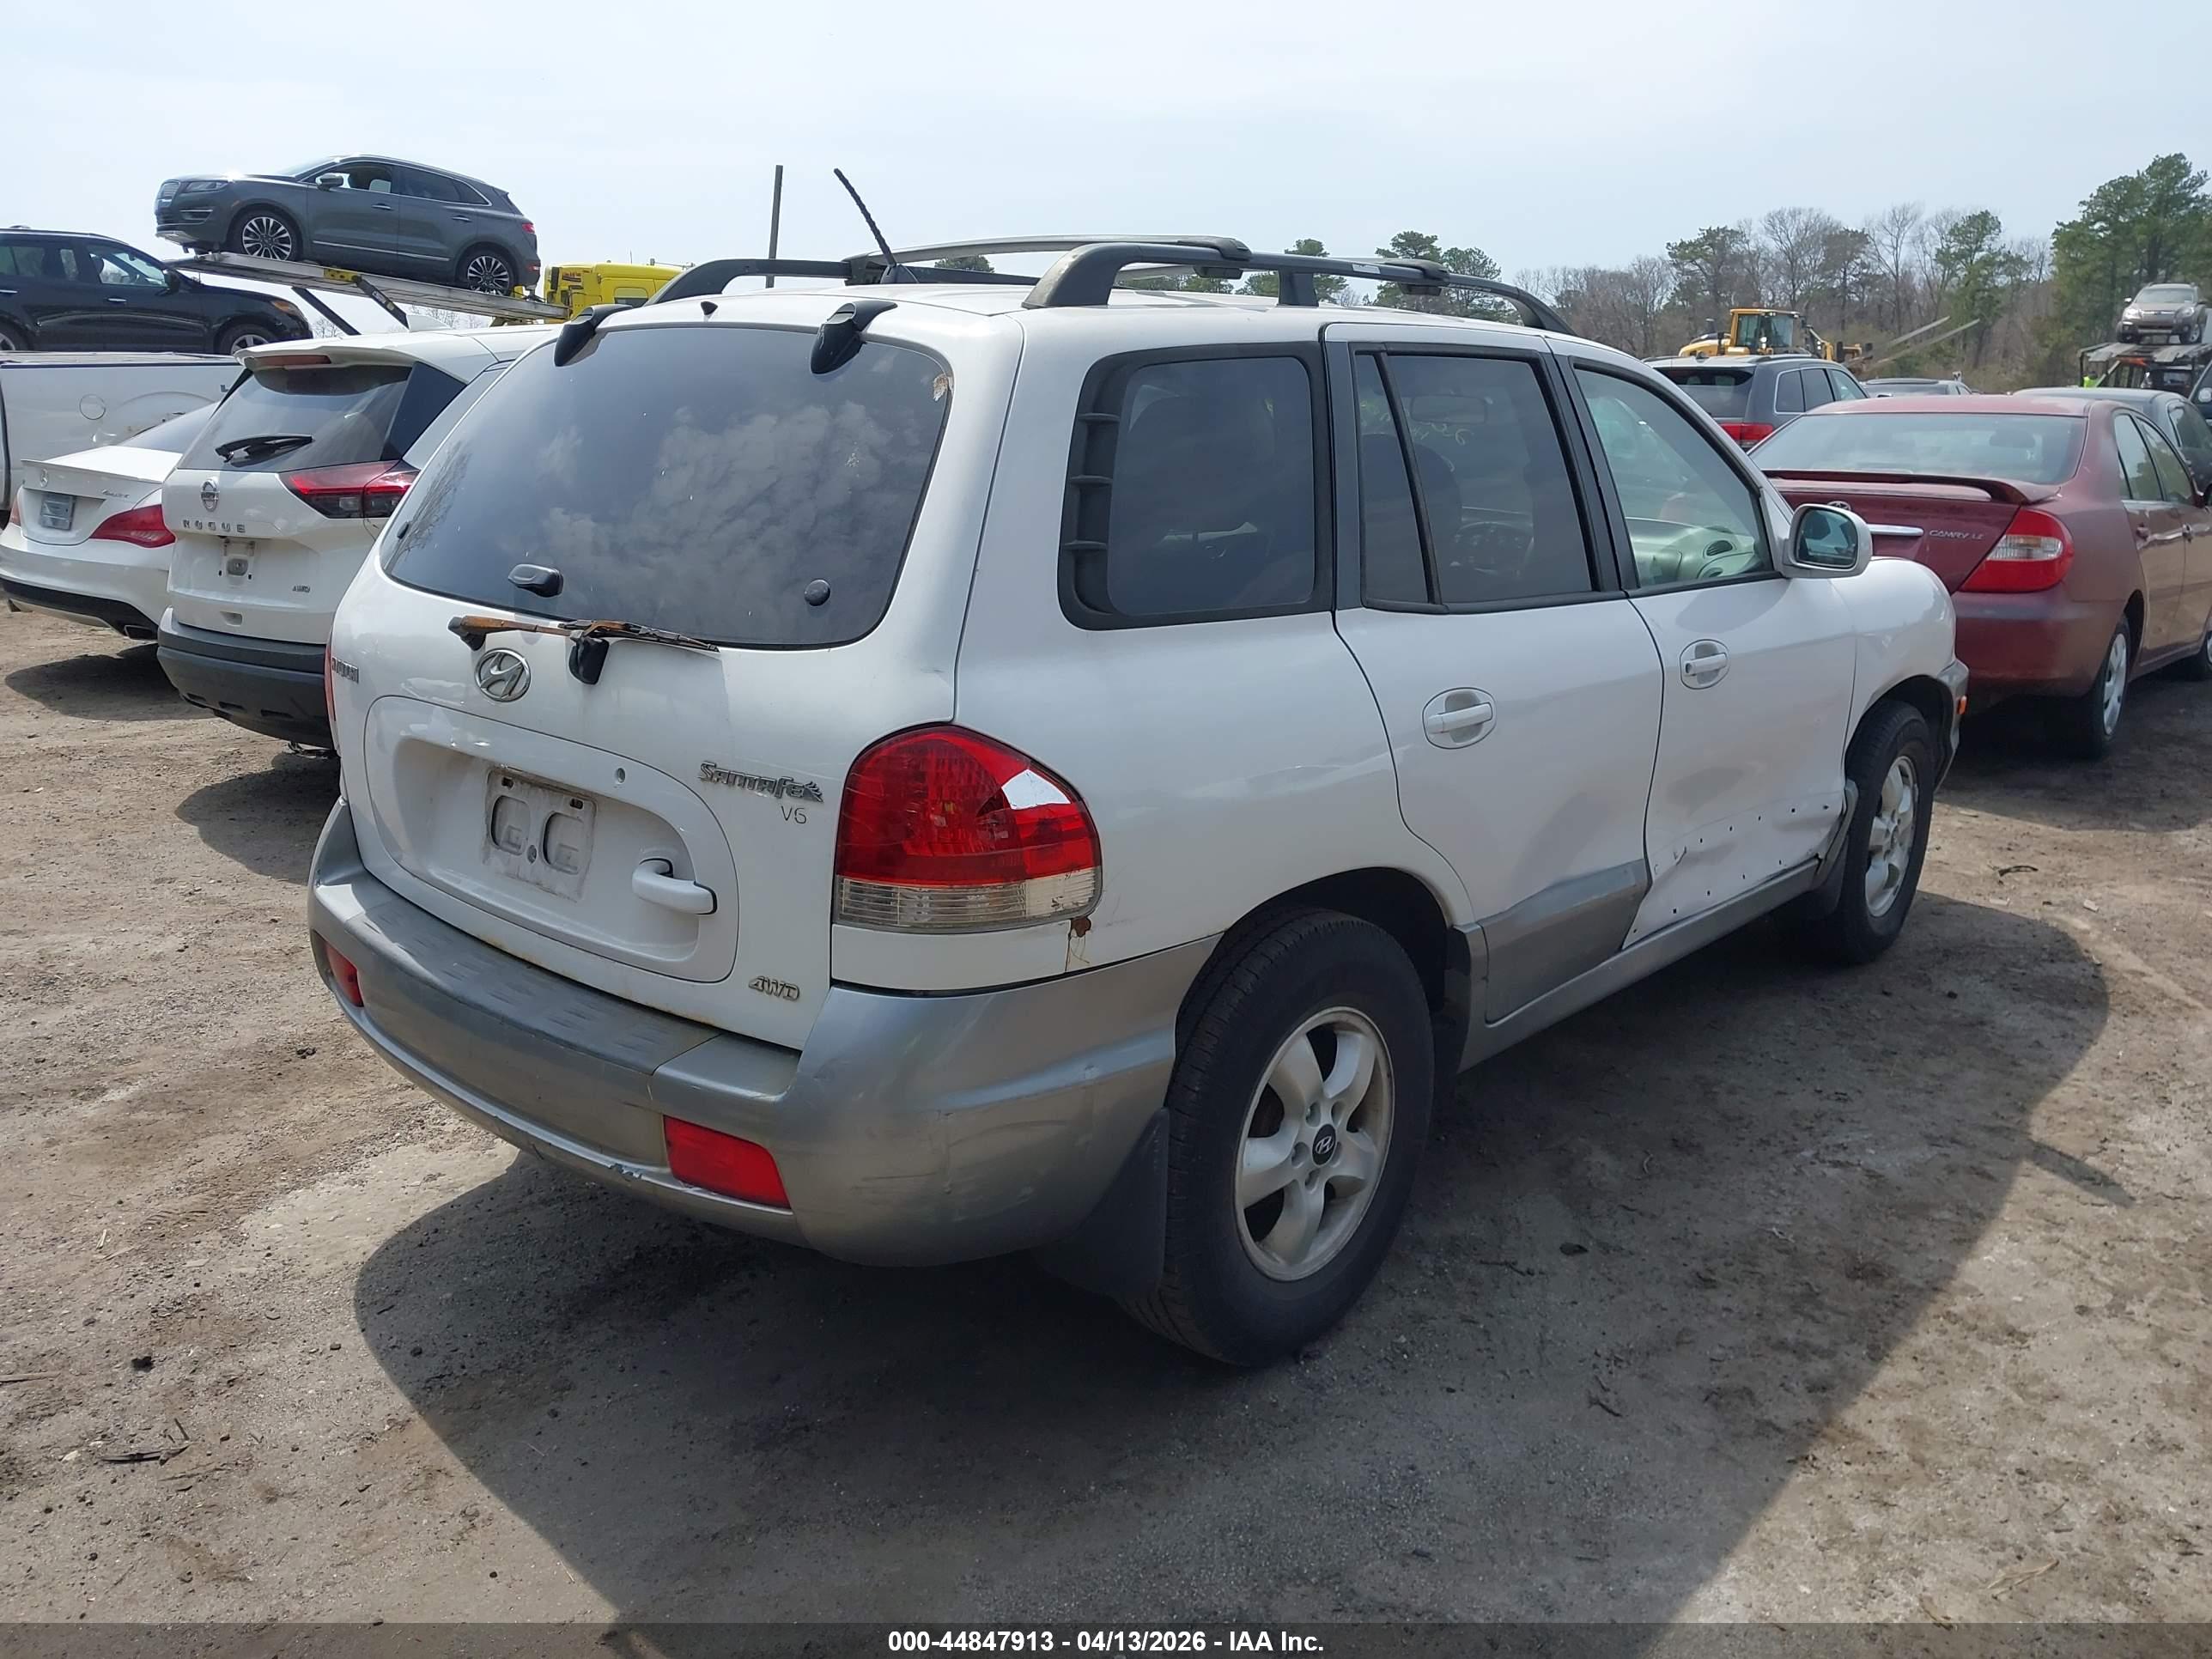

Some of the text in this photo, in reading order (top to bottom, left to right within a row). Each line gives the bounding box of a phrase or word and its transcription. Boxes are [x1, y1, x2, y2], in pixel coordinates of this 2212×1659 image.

[183, 520, 246, 533] ROGUE
[1929, 529, 1969, 539] CAMRY
[781, 805, 807, 824] V6
[749, 975, 799, 1002] 4WD
